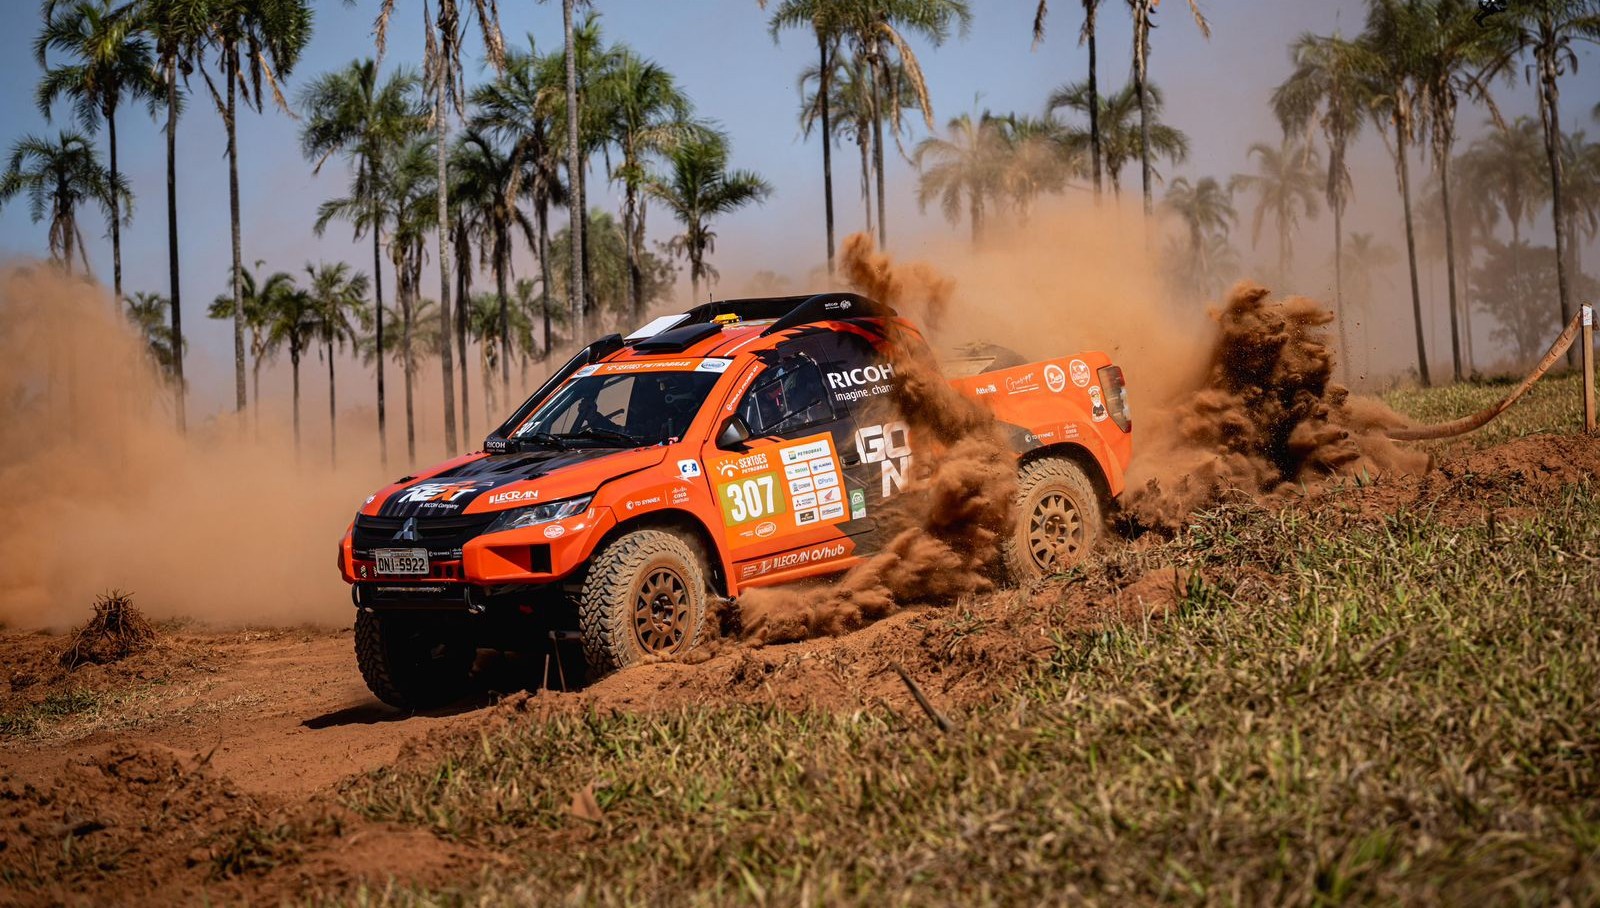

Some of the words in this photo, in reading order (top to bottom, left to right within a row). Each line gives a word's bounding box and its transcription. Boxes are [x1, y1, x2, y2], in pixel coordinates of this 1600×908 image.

[826, 363, 896, 389] RICOH
[835, 388, 871, 402] imagine.
[871, 384, 895, 395] chan
[797, 447, 822, 456] PETROBRAS
[738, 453, 768, 469] SERTÕES
[741, 463, 769, 474] PETROBRAS
[494, 490, 539, 501] LECRAN
[726, 475, 775, 522] 307
